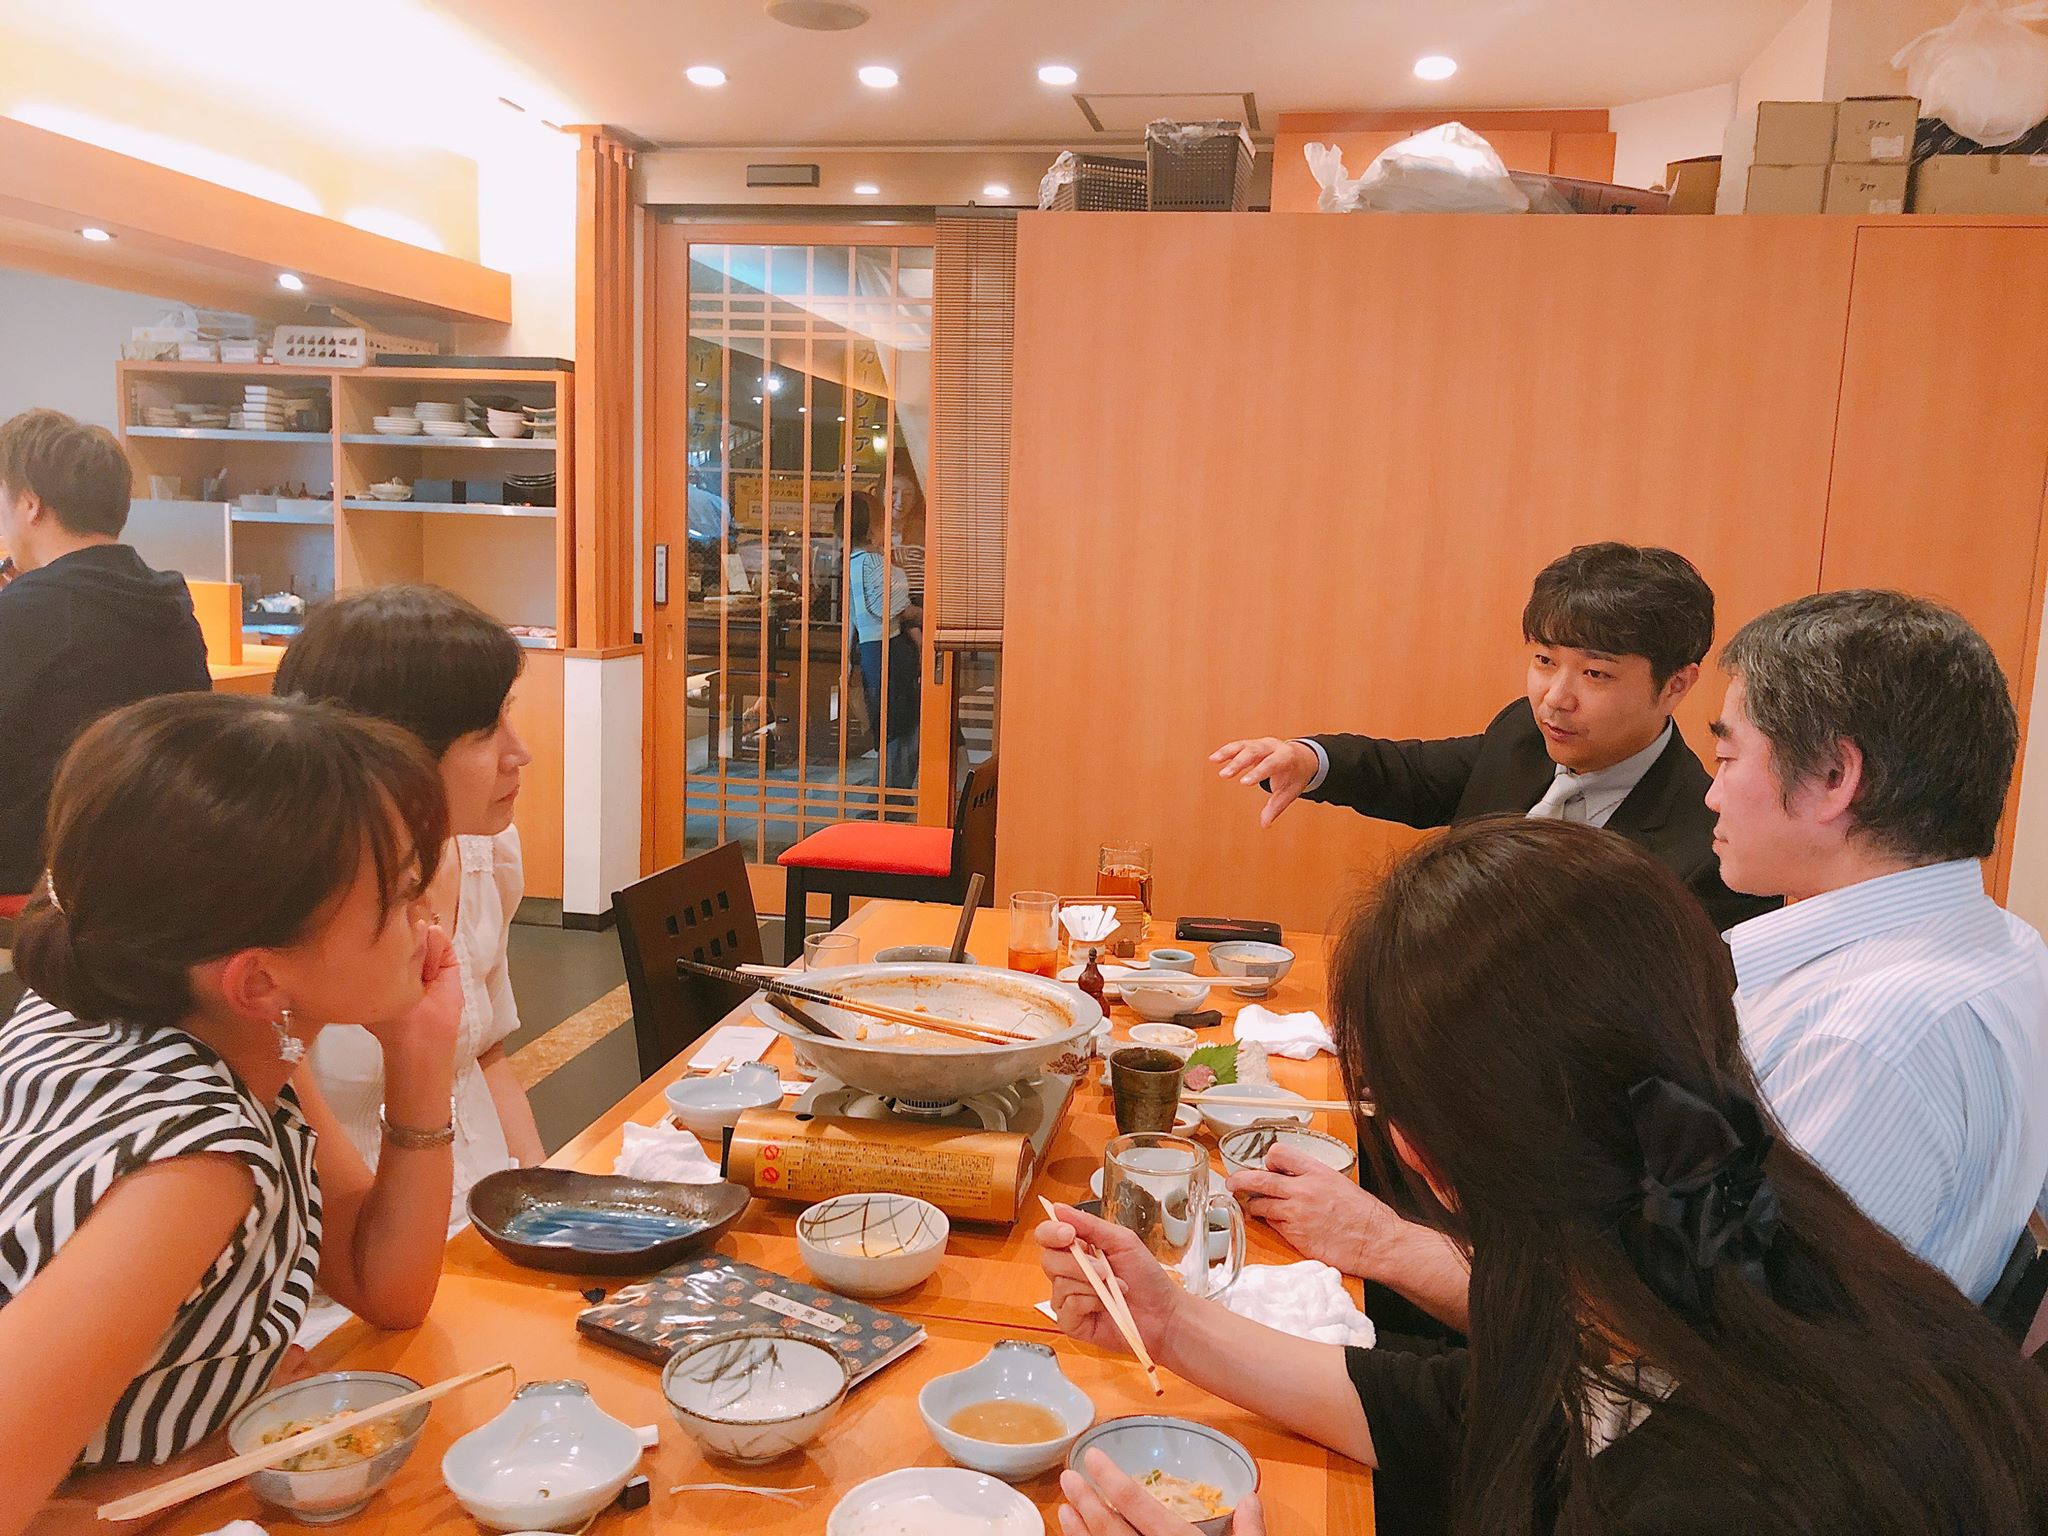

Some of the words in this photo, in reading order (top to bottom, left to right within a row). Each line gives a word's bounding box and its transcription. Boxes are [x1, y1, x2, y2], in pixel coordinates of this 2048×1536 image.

[854, 347, 876, 452] カーシェア
